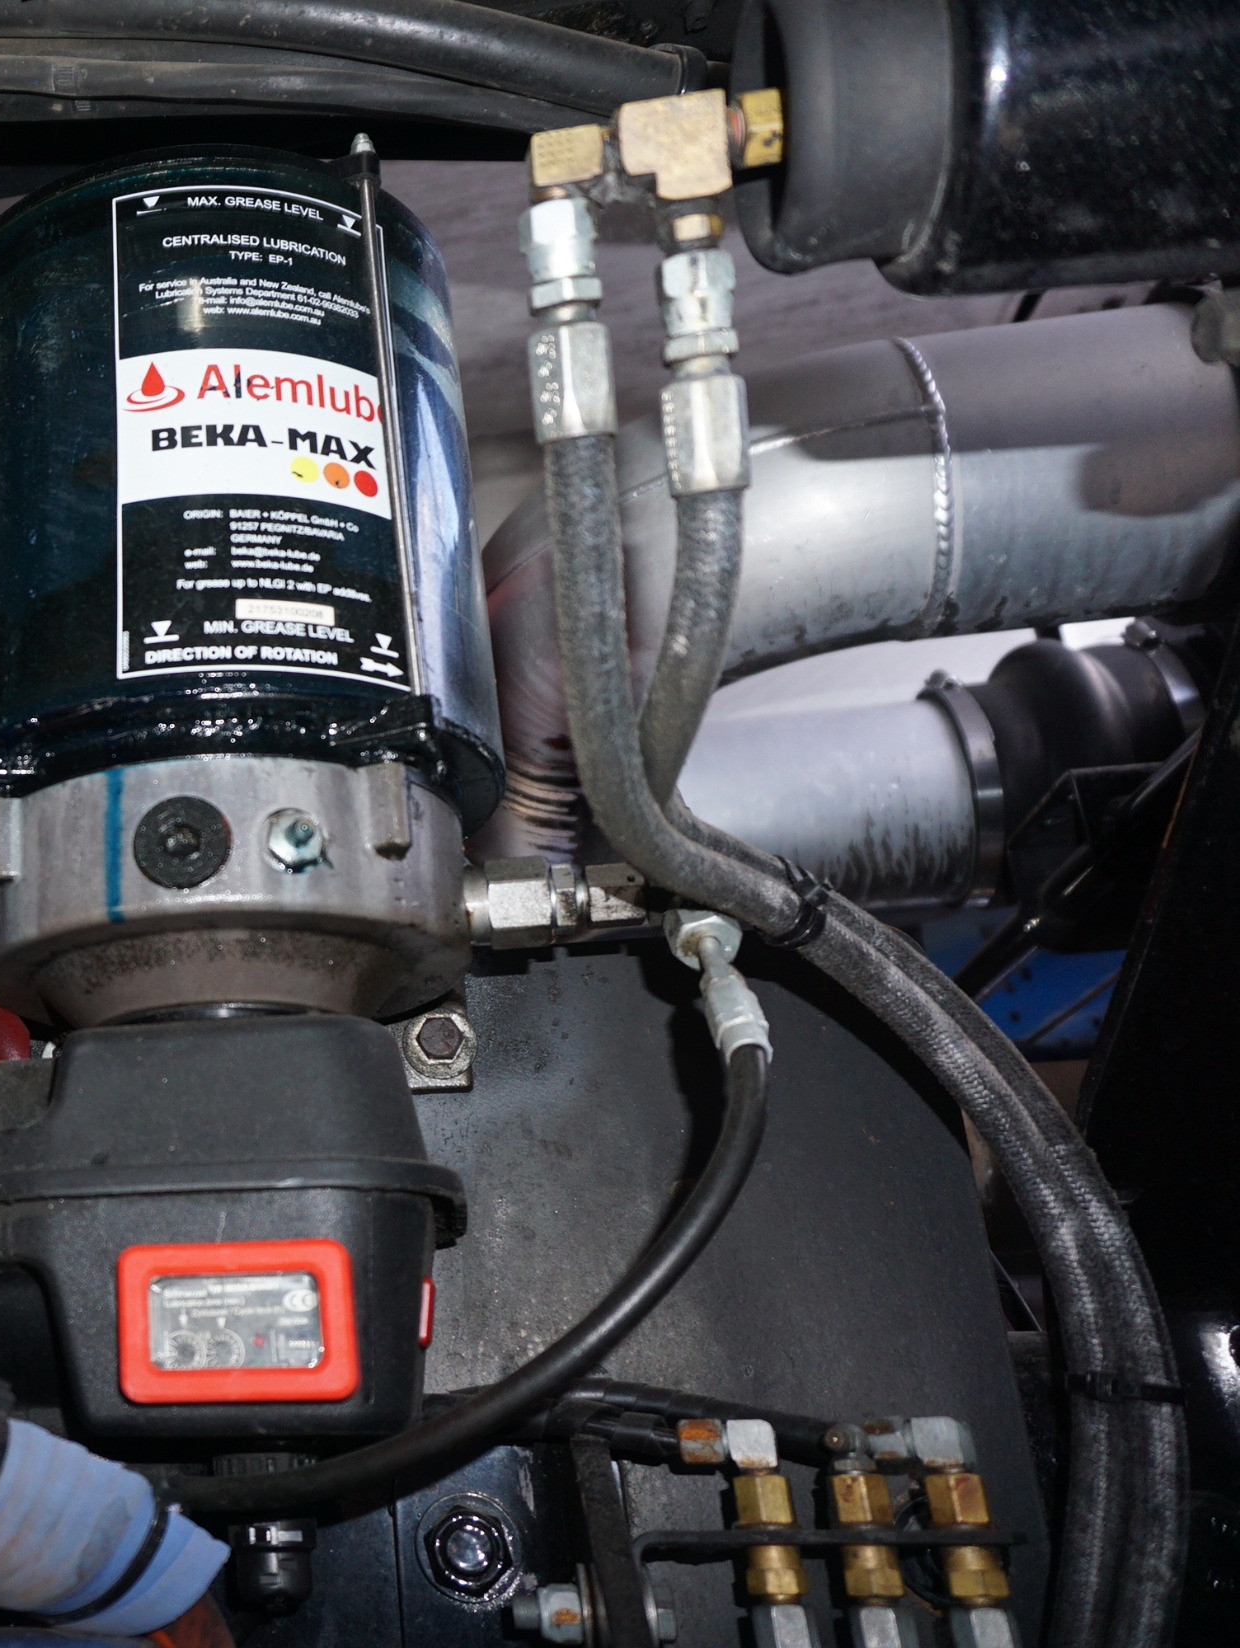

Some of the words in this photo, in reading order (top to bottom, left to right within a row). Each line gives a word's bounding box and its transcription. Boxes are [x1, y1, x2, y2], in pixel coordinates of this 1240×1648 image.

[187, 196, 222, 209] MAX.
[225, 196, 281, 212] GREASE
[284, 204, 324, 221] LEVEL
[162, 234, 260, 248] CENTRALISED
[263, 237, 347, 266] LUBRICATION
[229, 251, 263, 262] TYPE:
[269, 254, 293, 266] EP-1
[139, 283, 154, 293] For
[156, 279, 188, 290] service
[200, 277, 238, 286] Australia
[240, 278, 257, 287] and
[259, 278, 280, 289] New
[281, 281, 317, 297] Zealand,
[318, 290, 332, 300] call
[155, 286, 203, 299] Lubrication
[205, 286, 243, 297] Systems
[246, 287, 296, 301] Department
[197, 364, 384, 424] Alemlub
[151, 424, 377, 470] BEKA-MAX
[203, 620, 239, 635] MIN.
[241, 620, 307, 637] GREASE
[307, 624, 355, 644] LEVEL
[144, 645, 233, 665] DIRECTION
[233, 644, 258, 661] OF
[259, 645, 339, 666] ROTATION
